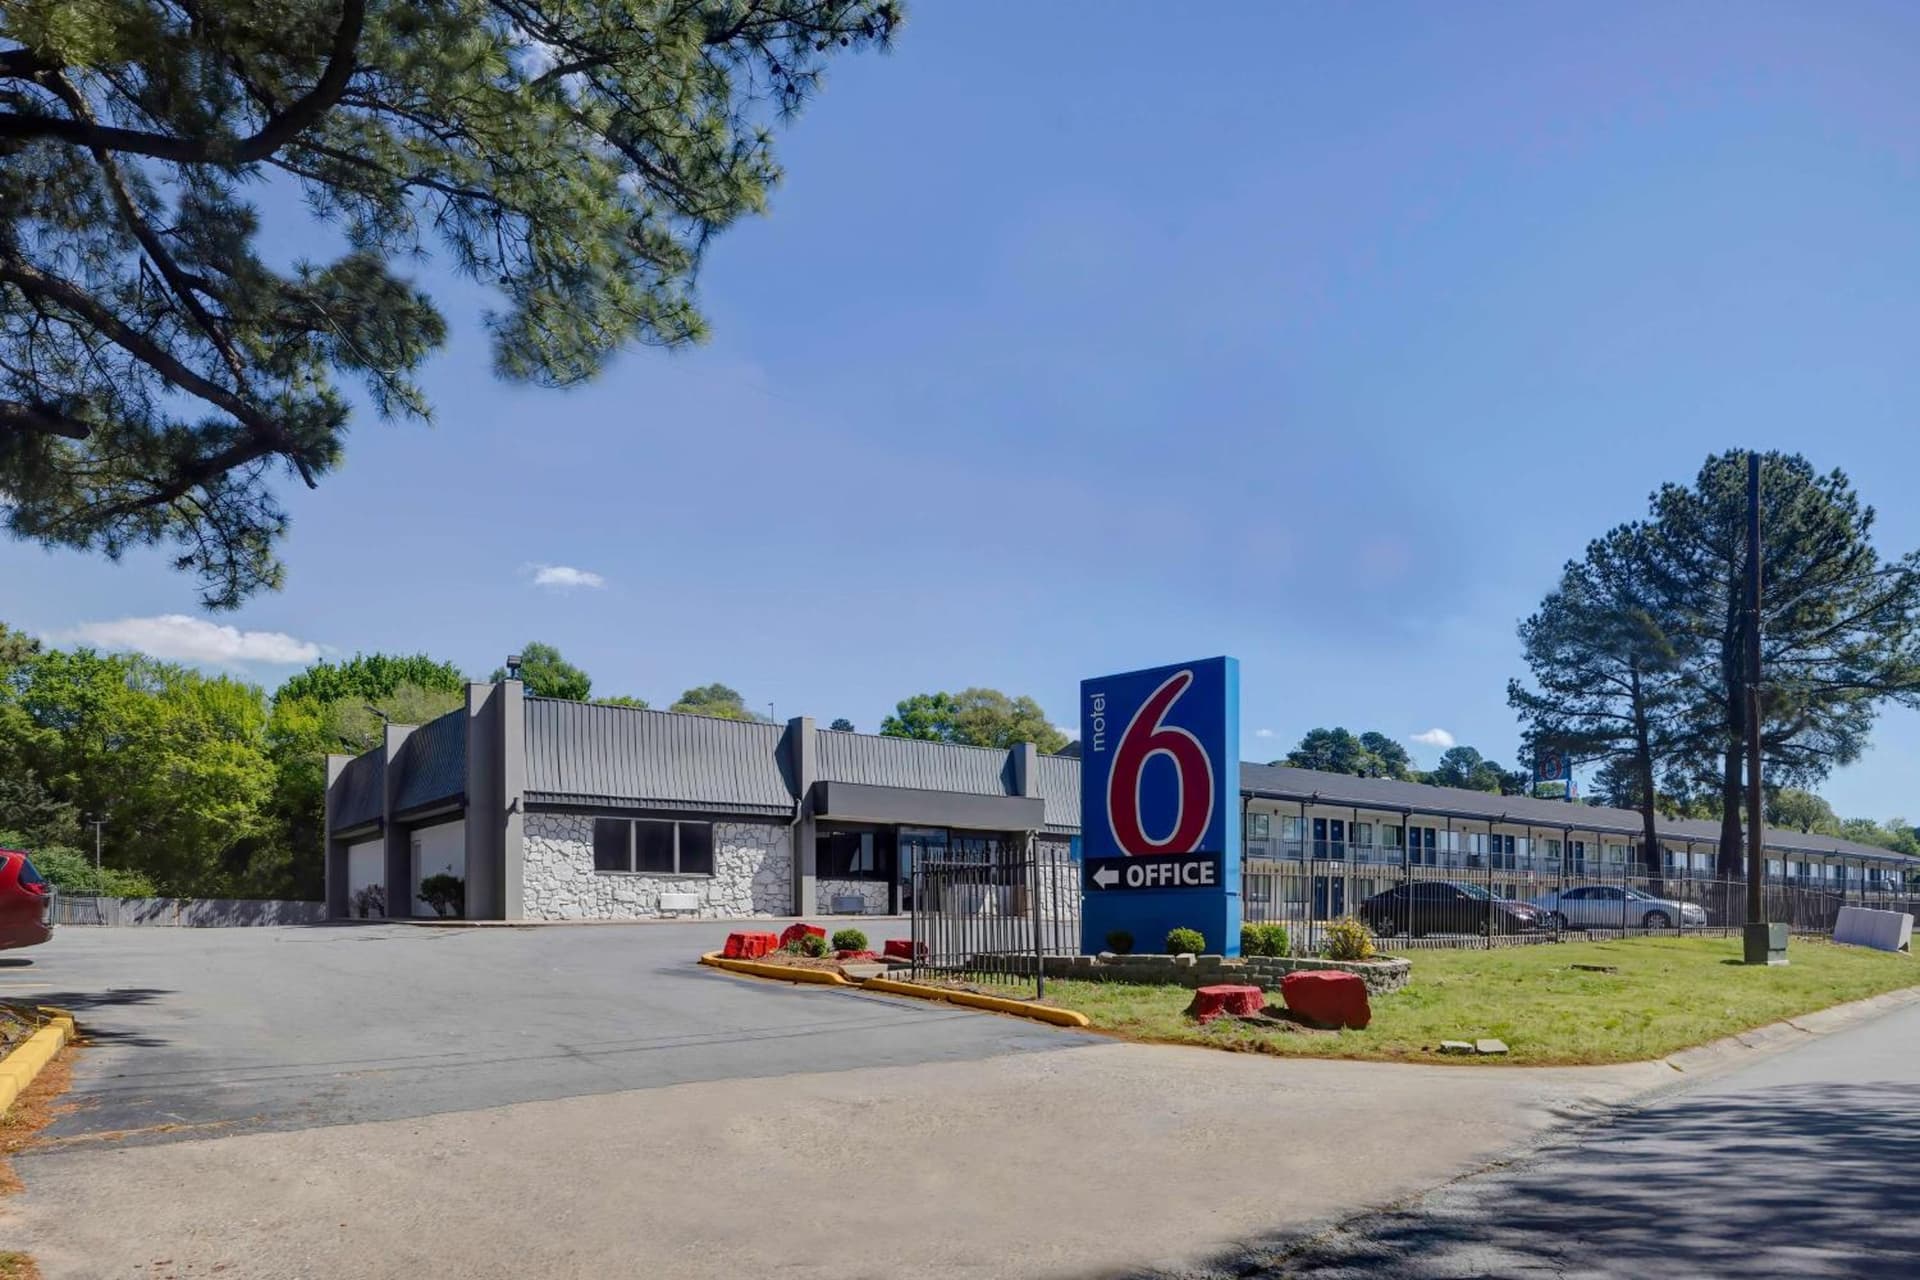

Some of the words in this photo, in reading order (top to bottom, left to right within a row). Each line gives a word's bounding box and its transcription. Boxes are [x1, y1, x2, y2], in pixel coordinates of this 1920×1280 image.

[1089, 692, 1106, 752] motel
[1107, 669, 1215, 857] 6
[1126, 861, 1215, 887] OFFICE
